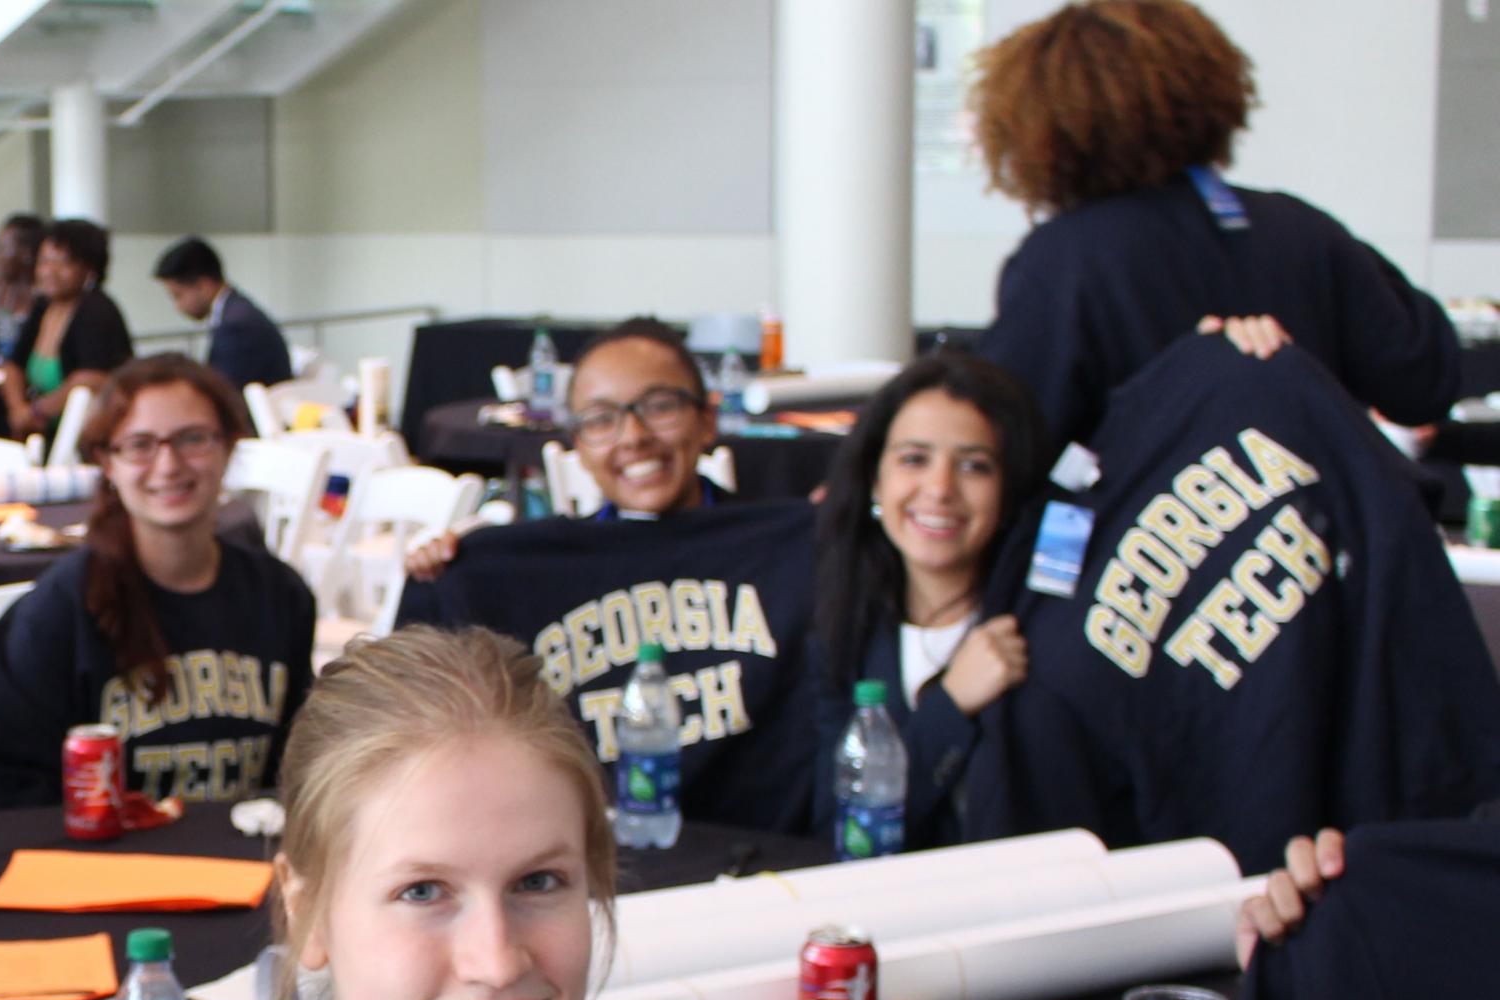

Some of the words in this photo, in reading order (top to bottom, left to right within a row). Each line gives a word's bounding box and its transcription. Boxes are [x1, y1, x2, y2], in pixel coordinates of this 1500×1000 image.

[1084, 426, 1321, 679] GEORGIA
[1163, 503, 1332, 691] TECH
[532, 578, 778, 698] GEORGIA
[579, 659, 750, 763] TCH
